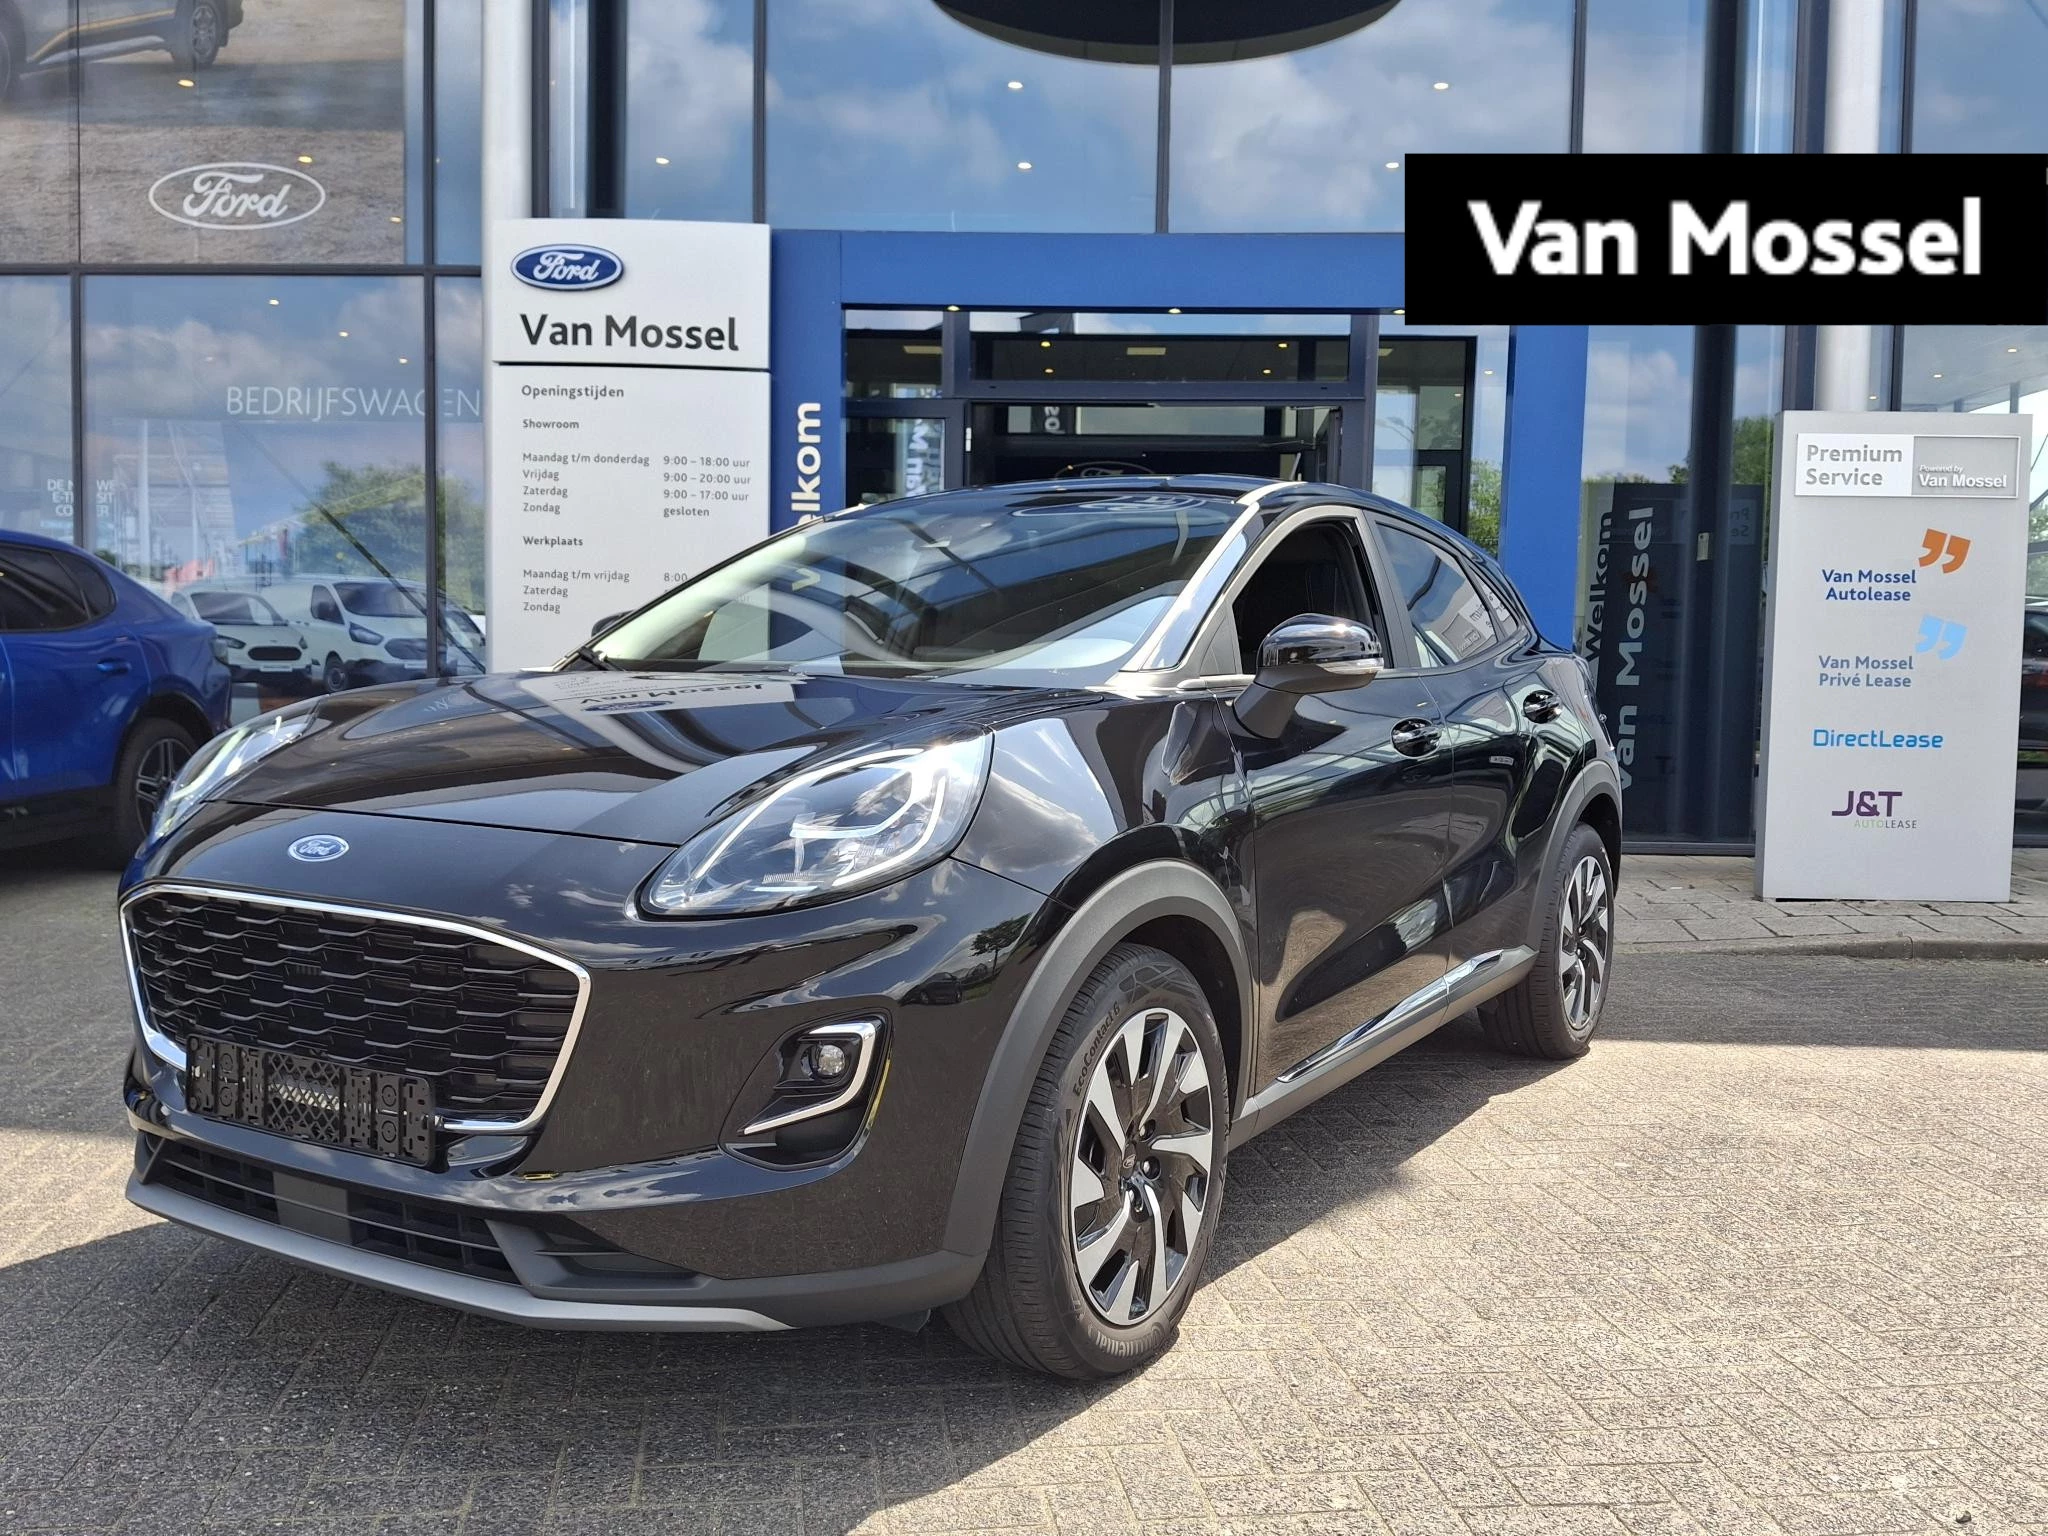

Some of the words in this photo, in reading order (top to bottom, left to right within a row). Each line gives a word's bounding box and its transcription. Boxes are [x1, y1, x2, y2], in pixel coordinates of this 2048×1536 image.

[183, 171, 292, 218] Ford
[532, 251, 601, 282] Ford
[520, 313, 592, 346] Van
[605, 314, 739, 351] Mossel
[521, 384, 625, 400] Openingstijden
[522, 418, 580, 430] Showroom
[522, 453, 569, 466] Maandag
[572, 453, 591, 465] t/m
[594, 454, 650, 467] donderdag
[663, 456, 688, 465] 9:00
[700, 456, 730, 467] 18:00
[733, 459, 751, 468] uur
[1806, 443, 1903, 463] Premium
[522, 469, 560, 482] Vrijdag
[663, 473, 688, 482] 9:00
[699, 473, 731, 484] 20:00
[734, 476, 751, 485] uur
[1805, 467, 1883, 486] Service
[1947, 465, 1964, 474] by
[1919, 473, 1947, 488] Van
[1951, 473, 2008, 488] Mossel
[522, 485, 569, 499] Zaterdag
[663, 489, 688, 499] 9:00
[700, 490, 729, 501] 17:00
[732, 493, 750, 501] uur
[522, 502, 561, 515] Zondag
[663, 506, 710, 518] gesloten
[522, 535, 584, 547] Werkplaats
[522, 569, 569, 582] Maandag
[572, 569, 591, 580] t/m
[594, 570, 630, 583] vrijdag
[663, 572, 688, 582] 8:00
[1821, 569, 1853, 583] Van
[1858, 569, 1917, 584] Mossel
[522, 585, 569, 598] Zaterdag
[1585, 511, 1613, 662] Welkom
[1825, 587, 1912, 601] Autolease
[1615, 507, 1655, 687] Mossel
[522, 601, 561, 614] Zondag
[1818, 656, 1850, 670] Van
[1855, 656, 1914, 670] Mossel
[1819, 673, 1861, 687] Privé
[1866, 673, 1912, 688] Lease
[1812, 729, 1944, 748] DirectLease
[1831, 790, 1903, 817] J&T
[1854, 819, 1918, 829] AUTOLEASE
[298, 840, 336, 857] Ford
[1072, 1012, 1114, 1097] EcoContact
